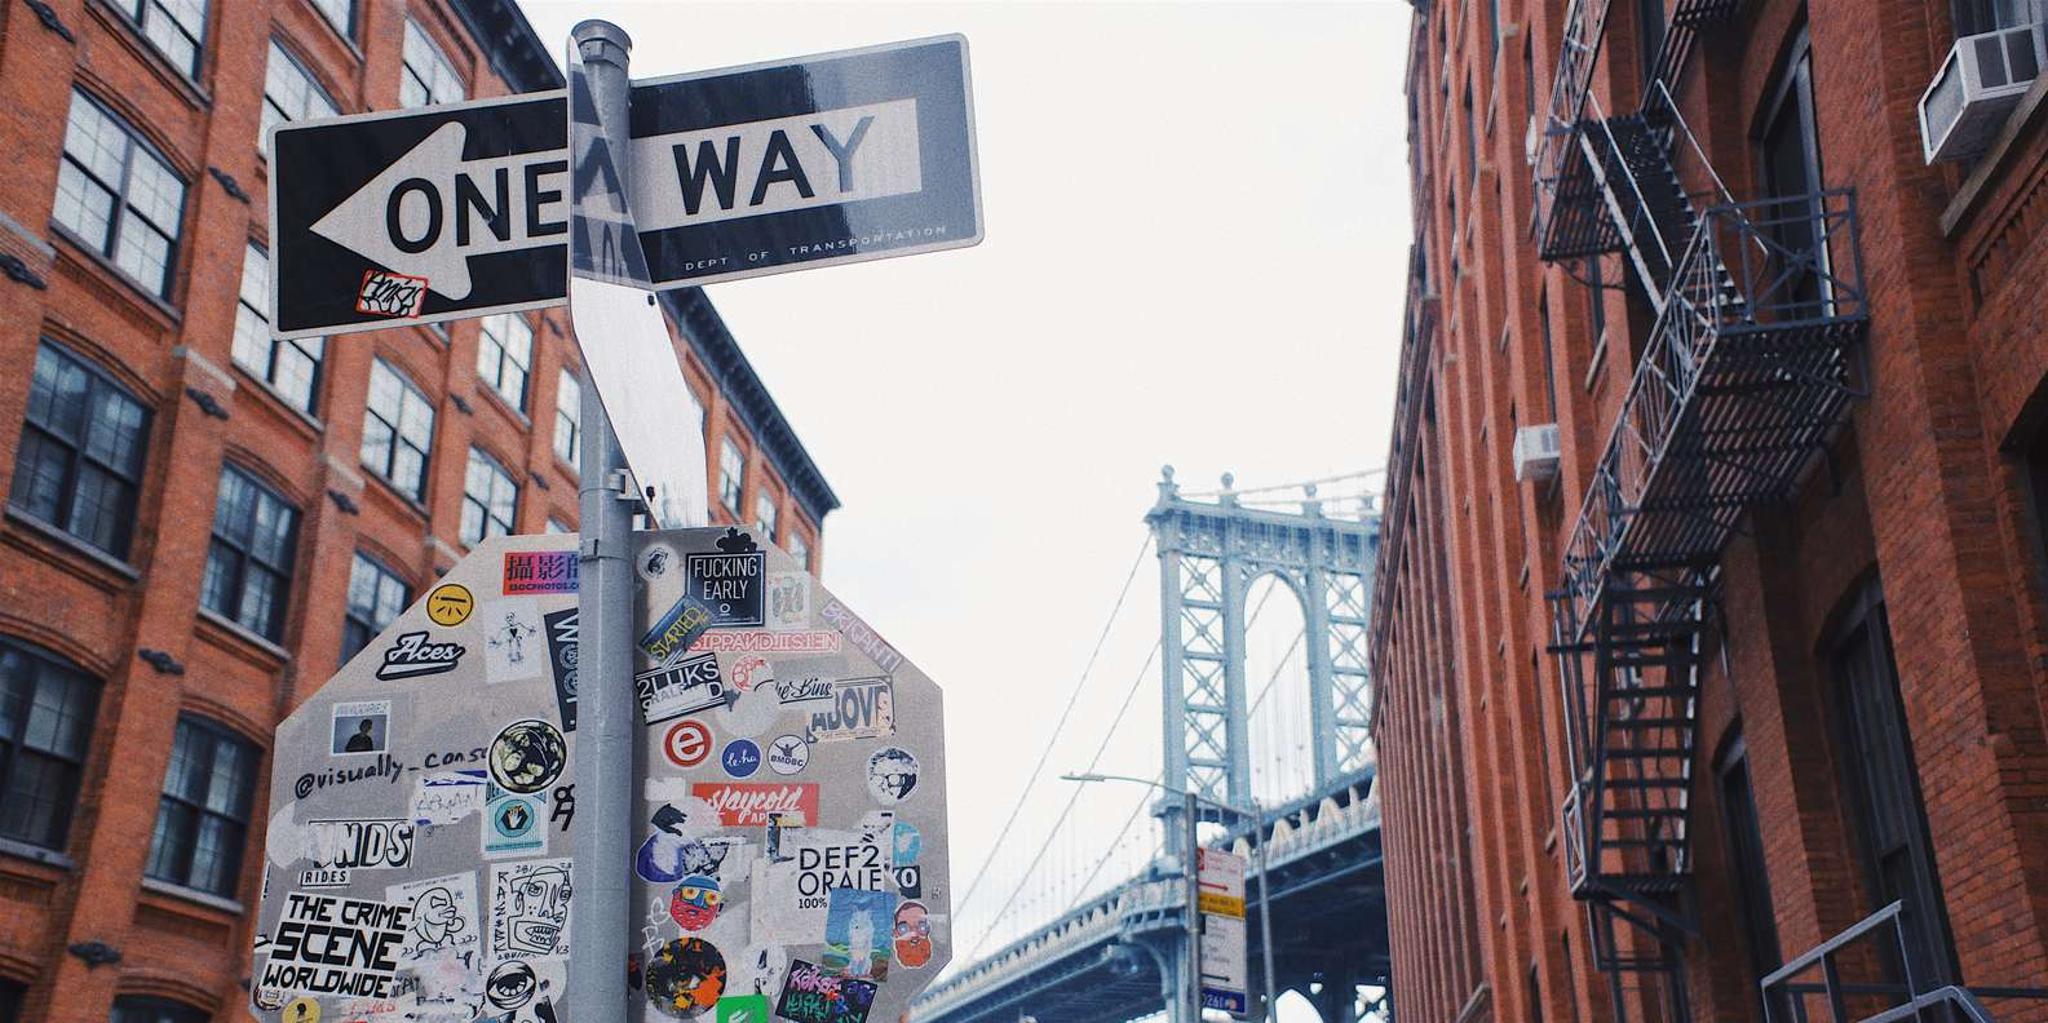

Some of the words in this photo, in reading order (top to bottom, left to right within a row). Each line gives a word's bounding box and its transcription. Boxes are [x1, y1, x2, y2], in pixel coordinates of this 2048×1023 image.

[386, 159, 568, 254] ONE
[671, 114, 876, 216] WAY
[684, 256, 729, 272] DEPT
[748, 250, 772, 263] OF
[789, 224, 948, 257] TRANSPORTATION
[693, 556, 758, 579] FUCKING
[703, 579, 750, 601] EARLY
[388, 634, 464, 664] Aces
[671, 726, 705, 762] e
[799, 844, 881, 872] DEF2
[304, 870, 347, 884] RIDES
[288, 894, 337, 923] THE
[340, 900, 412, 931] CRIME
[798, 897, 828, 909] 100%
[270, 921, 405, 972] SCENE
[262, 963, 393, 999] WORLDWIDE
